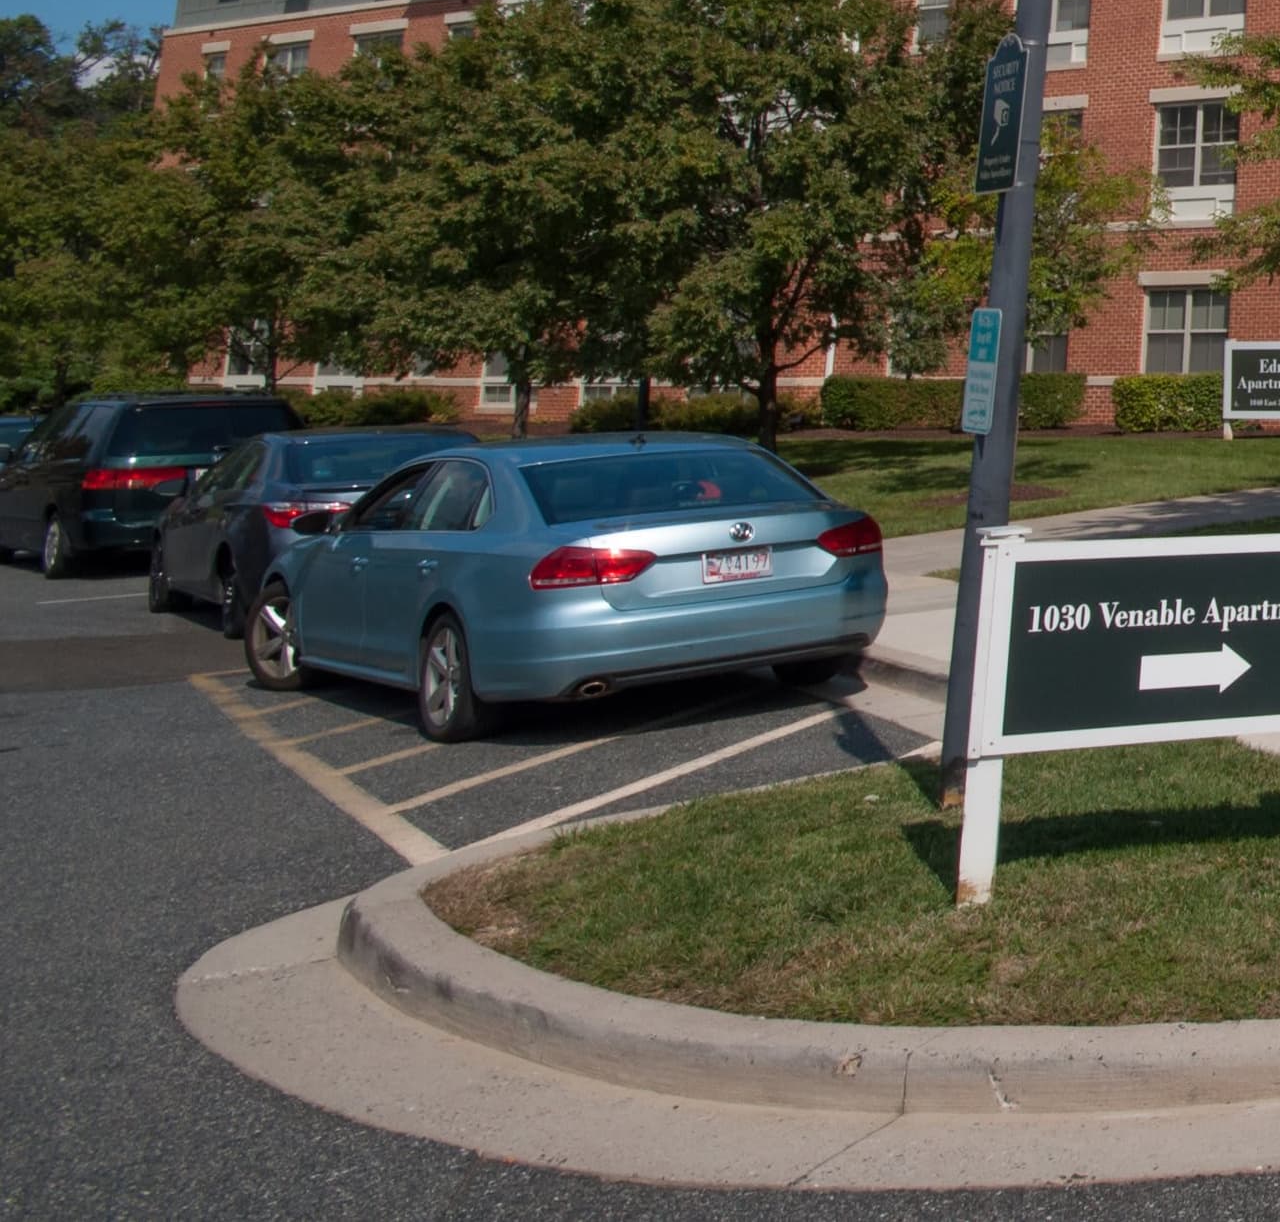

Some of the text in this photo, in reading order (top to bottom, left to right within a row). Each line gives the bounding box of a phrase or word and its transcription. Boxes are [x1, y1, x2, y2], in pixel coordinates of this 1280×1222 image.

[993, 60, 1019, 78] SECURITY
[994, 79, 1015, 93] NOTICE
[1027, 604, 1091, 633] 1030
[1099, 599, 1196, 630] Venable
